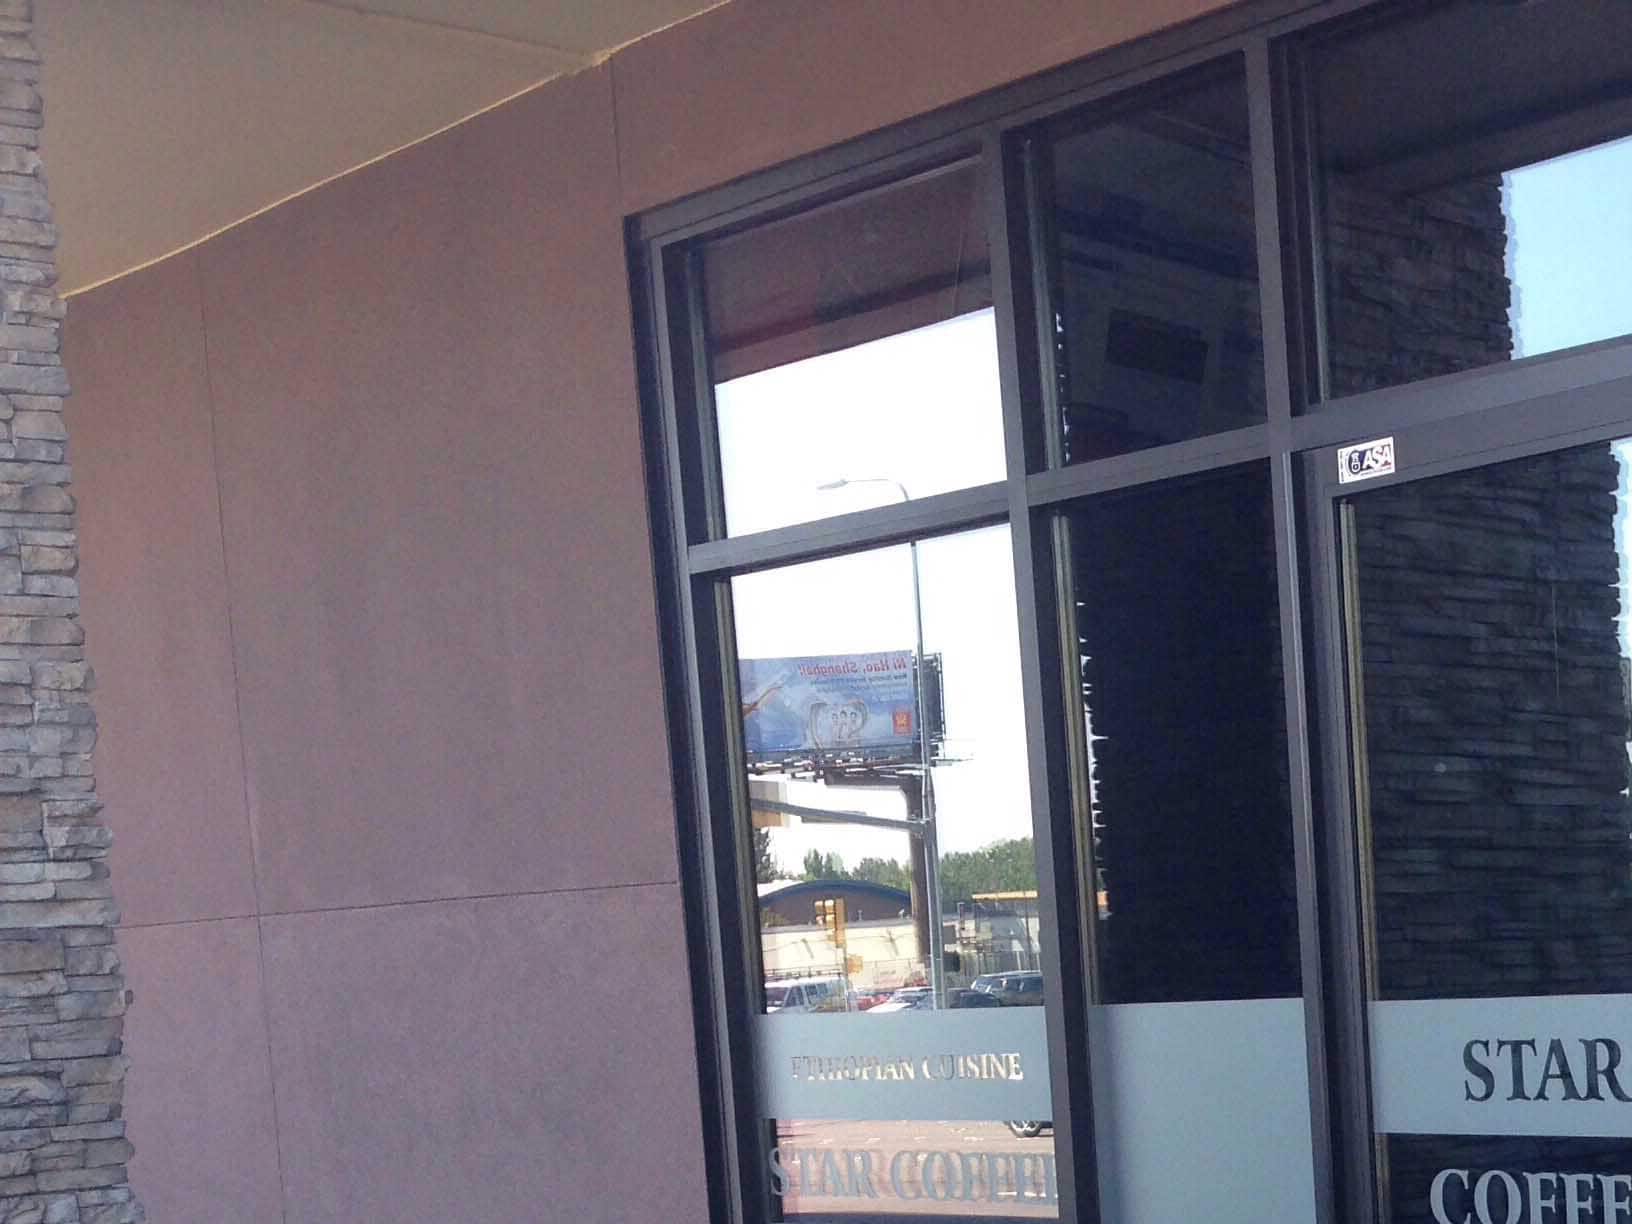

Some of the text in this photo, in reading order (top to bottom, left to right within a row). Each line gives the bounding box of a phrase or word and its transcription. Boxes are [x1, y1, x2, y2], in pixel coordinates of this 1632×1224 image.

[790, 1052, 1025, 1081] ETHIOPIAN CUISINE
[1462, 1037, 1632, 1103] STAR
[767, 1147, 880, 1199] STAR
